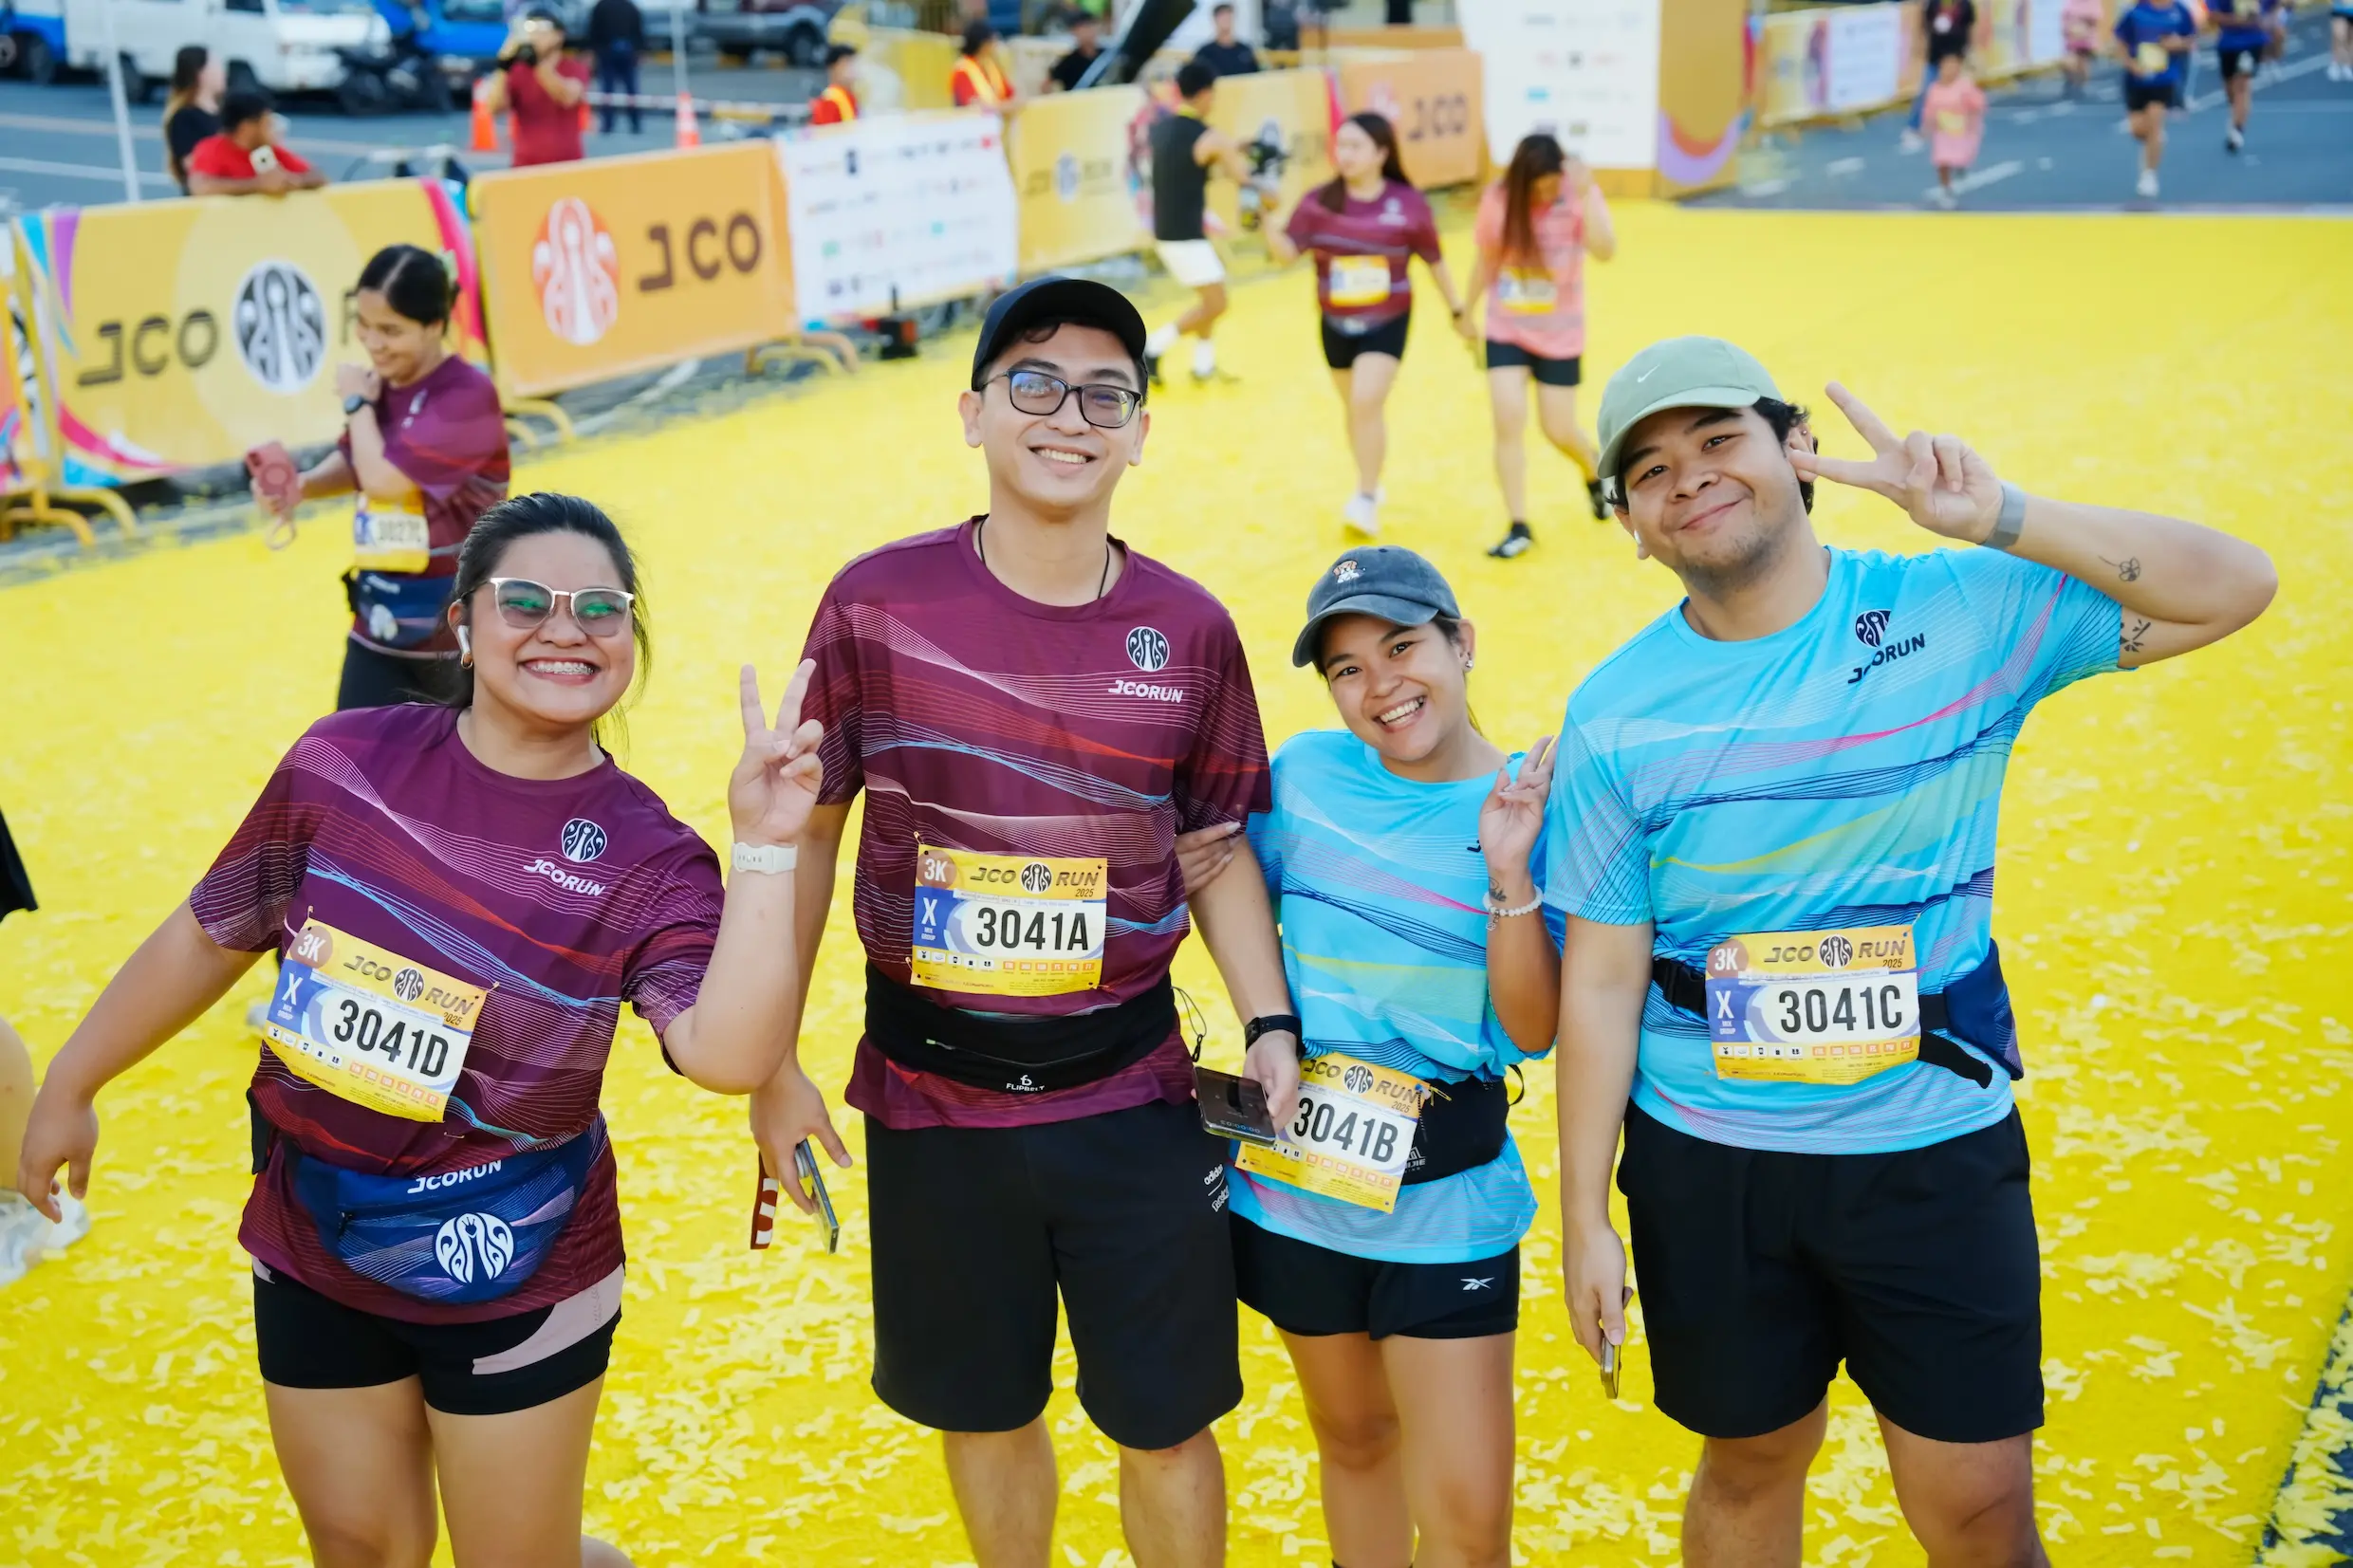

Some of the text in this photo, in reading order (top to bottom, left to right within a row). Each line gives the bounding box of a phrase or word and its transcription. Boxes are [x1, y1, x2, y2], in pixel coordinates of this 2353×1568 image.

[639, 212, 761, 292] JCO
[77, 309, 219, 386] JCO
[1107, 679, 1183, 703] JCORUN
[523, 858, 606, 896] JCORUN
[924, 858, 948, 882] 3K
[970, 867, 1099, 887] JCO RUN
[1075, 888, 1094, 897] 2025
[921, 896, 937, 927] X
[976, 907, 1089, 950] 3041A
[297, 932, 325, 962] 3K
[1714, 948, 1738, 971] 3K
[1764, 939, 1906, 963] JCO RUN
[1882, 958, 1903, 968] 2025
[282, 972, 303, 1005] X
[343, 955, 392, 982] JCO
[425, 987, 474, 1015] RUN
[1715, 990, 1734, 1020] X
[1779, 985, 1902, 1033] 3041C
[334, 999, 449, 1078] 3041D
[1304, 1059, 1341, 1079] JCO
[1376, 1079, 1417, 1103] RUN
[1391, 1100, 1412, 1114] 2025
[1293, 1097, 1399, 1163] 3041B
[407, 1159, 502, 1194] JCORUN
